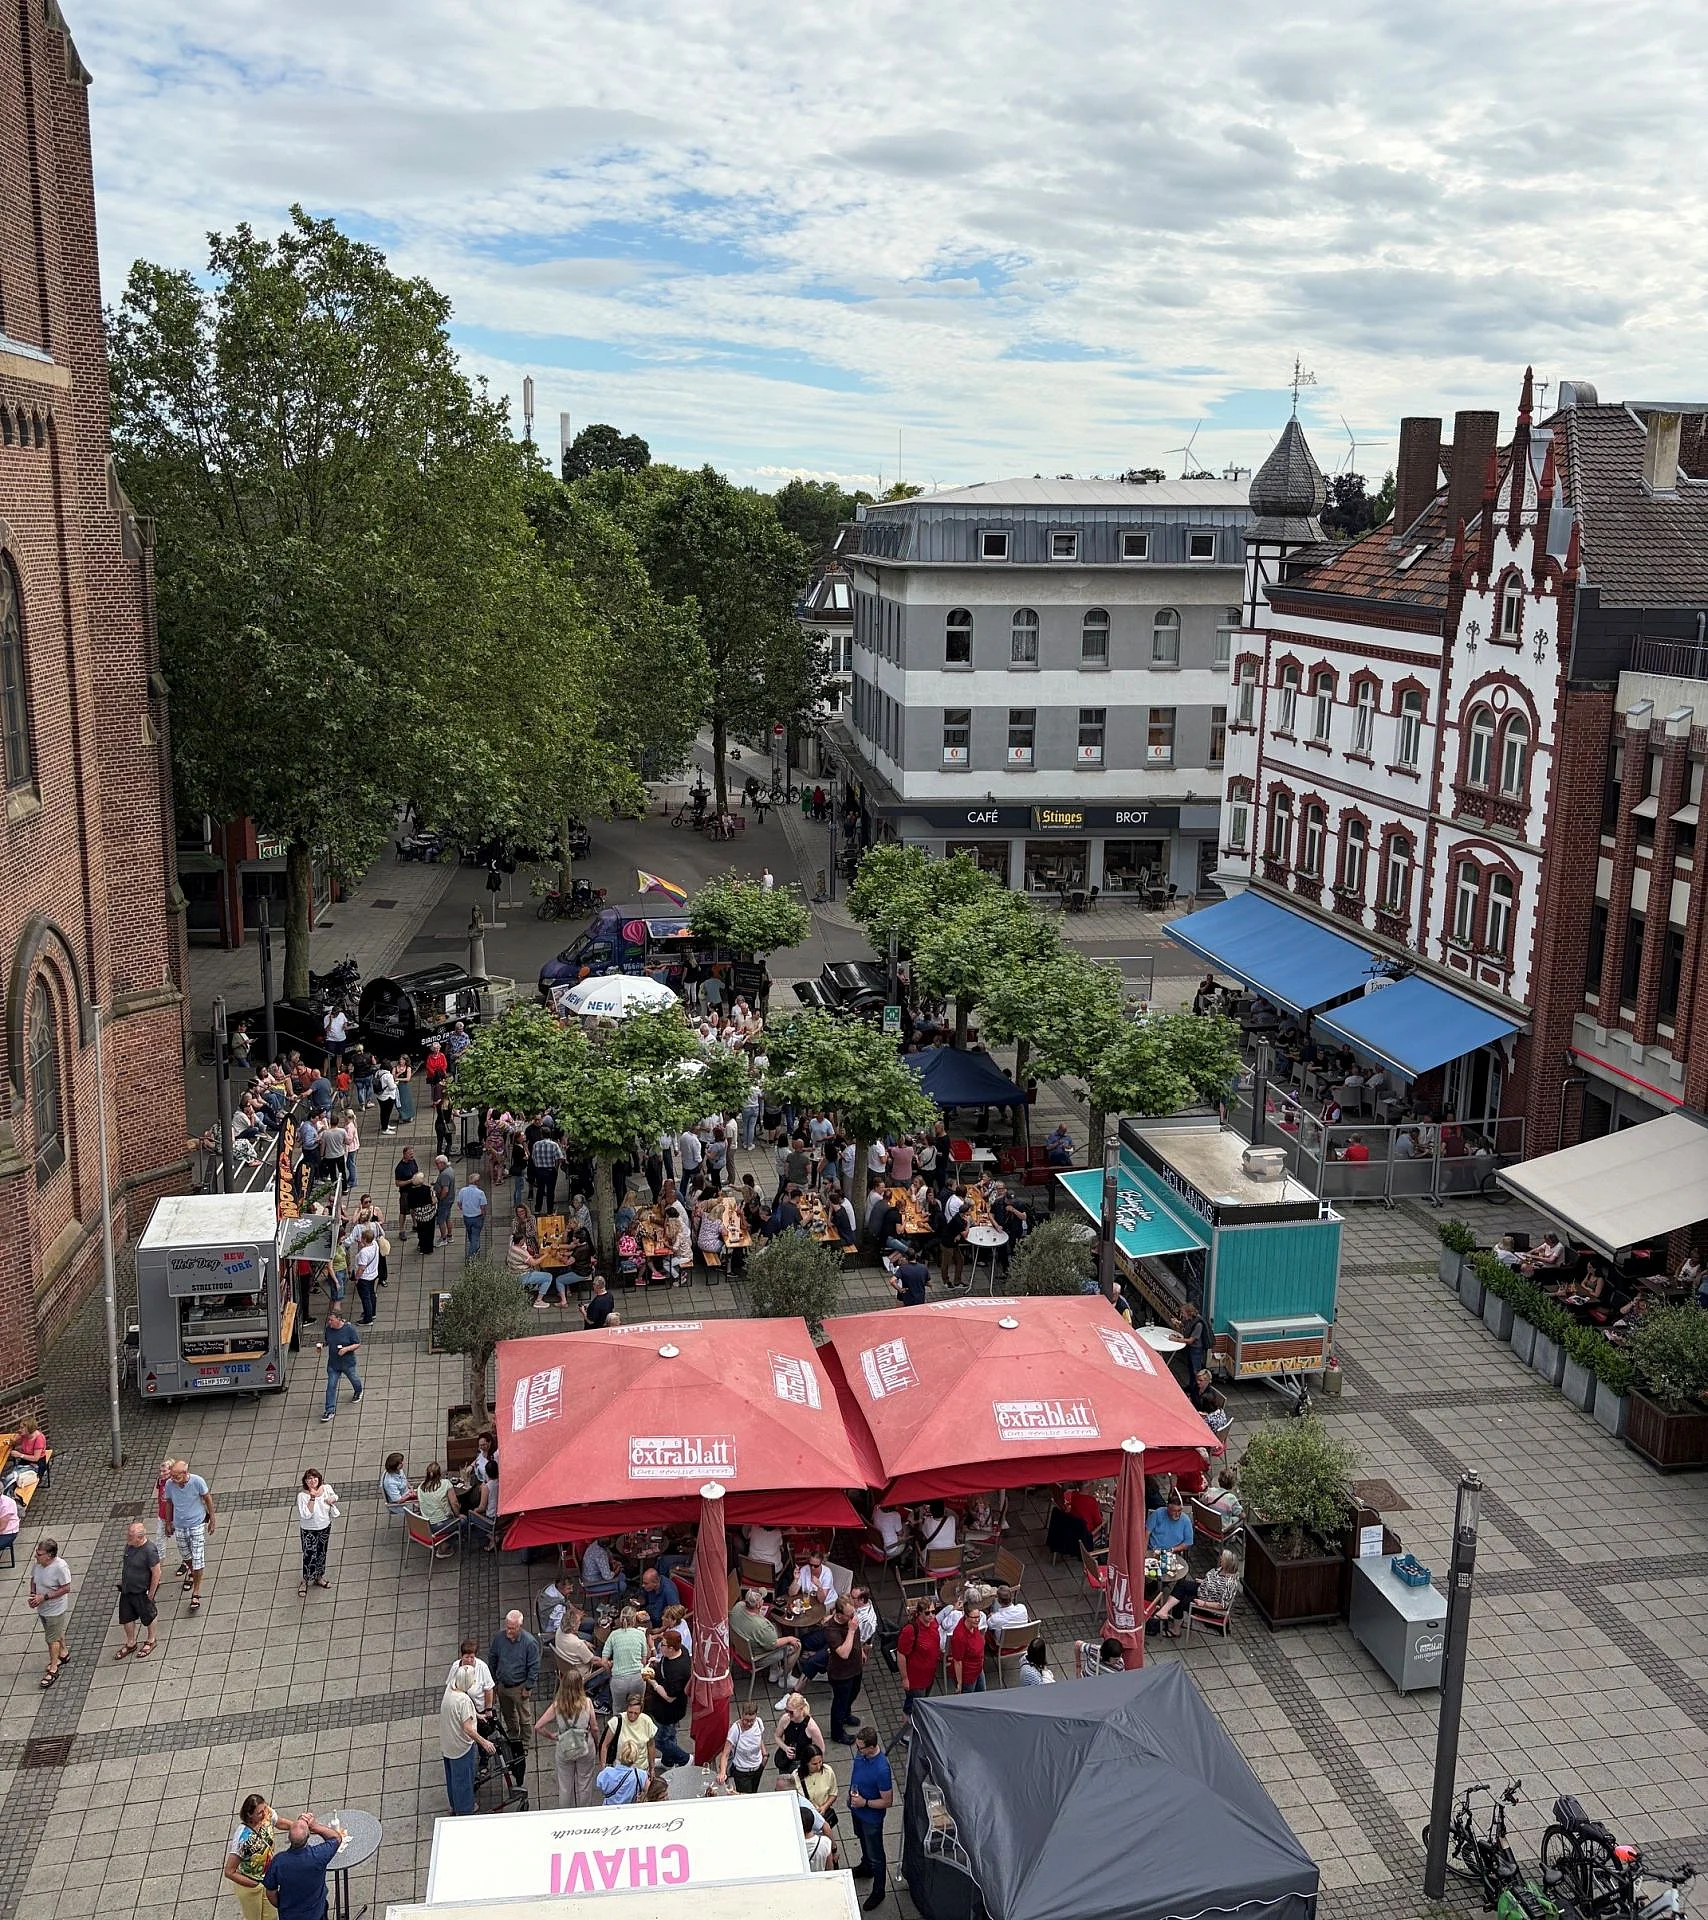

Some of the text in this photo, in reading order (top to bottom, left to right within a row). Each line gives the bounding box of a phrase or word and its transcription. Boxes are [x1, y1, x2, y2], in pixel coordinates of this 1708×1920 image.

[967, 808, 999, 823] CAFÉ
[1041, 810, 1083, 825] Stinges
[1115, 811, 1149, 823] BROT
[565, 992, 582, 1006] NEW
[586, 1000, 616, 1011] NEW
[223, 1251, 245, 1261] NEW
[171, 1257, 222, 1272] Hot Dog
[223, 1259, 253, 1275] YORK
[199, 1363, 251, 1376] NEW YORK
[999, 1402, 1091, 1428] extrablatt
[632, 1438, 733, 1465] extrablatt
[551, 1817, 685, 1839] German Vermouth
[550, 1844, 690, 1896] CHAVI
